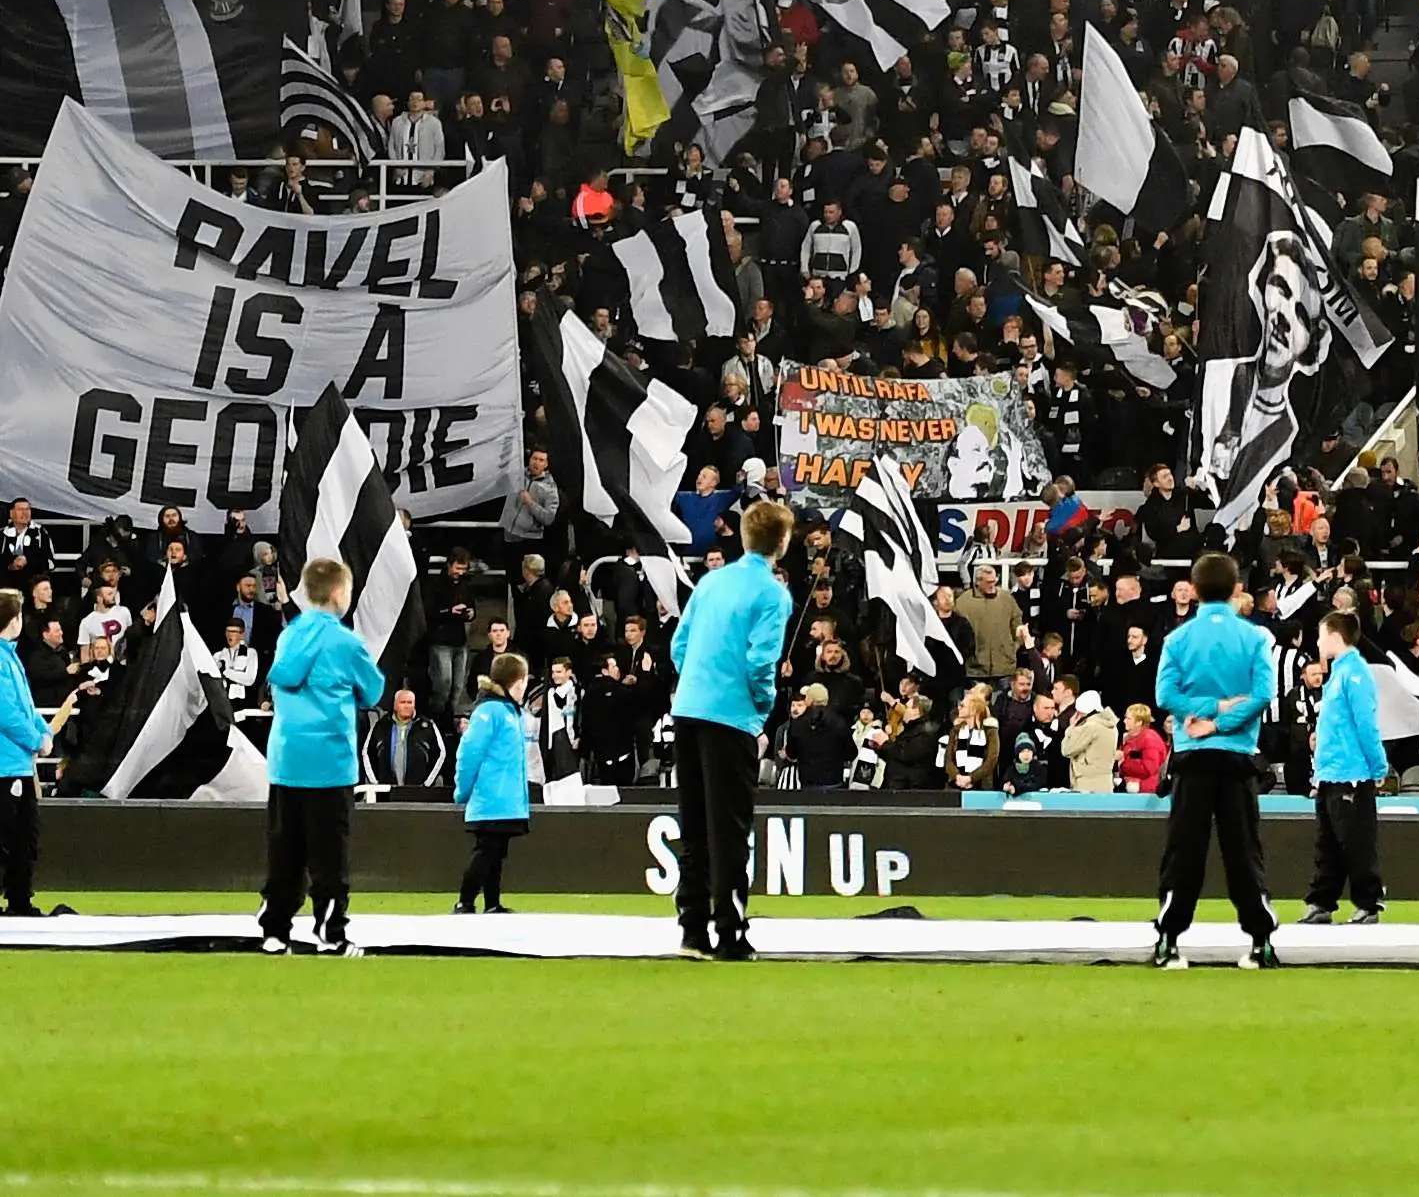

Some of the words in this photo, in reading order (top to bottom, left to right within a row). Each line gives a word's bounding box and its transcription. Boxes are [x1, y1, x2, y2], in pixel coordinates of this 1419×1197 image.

[173, 197, 458, 300] PAVEL
[192, 285, 304, 396] IS
[342, 302, 406, 400] A
[800, 365, 874, 399] UNTIL
[874, 378, 933, 402] RAFA
[67, 387, 479, 511] GEODIE
[800, 410, 811, 435] I
[814, 411, 876, 442] WAS
[878, 417, 958, 445] NEVER
[794, 452, 927, 492] HAPY
[645, 814, 806, 897] SN
